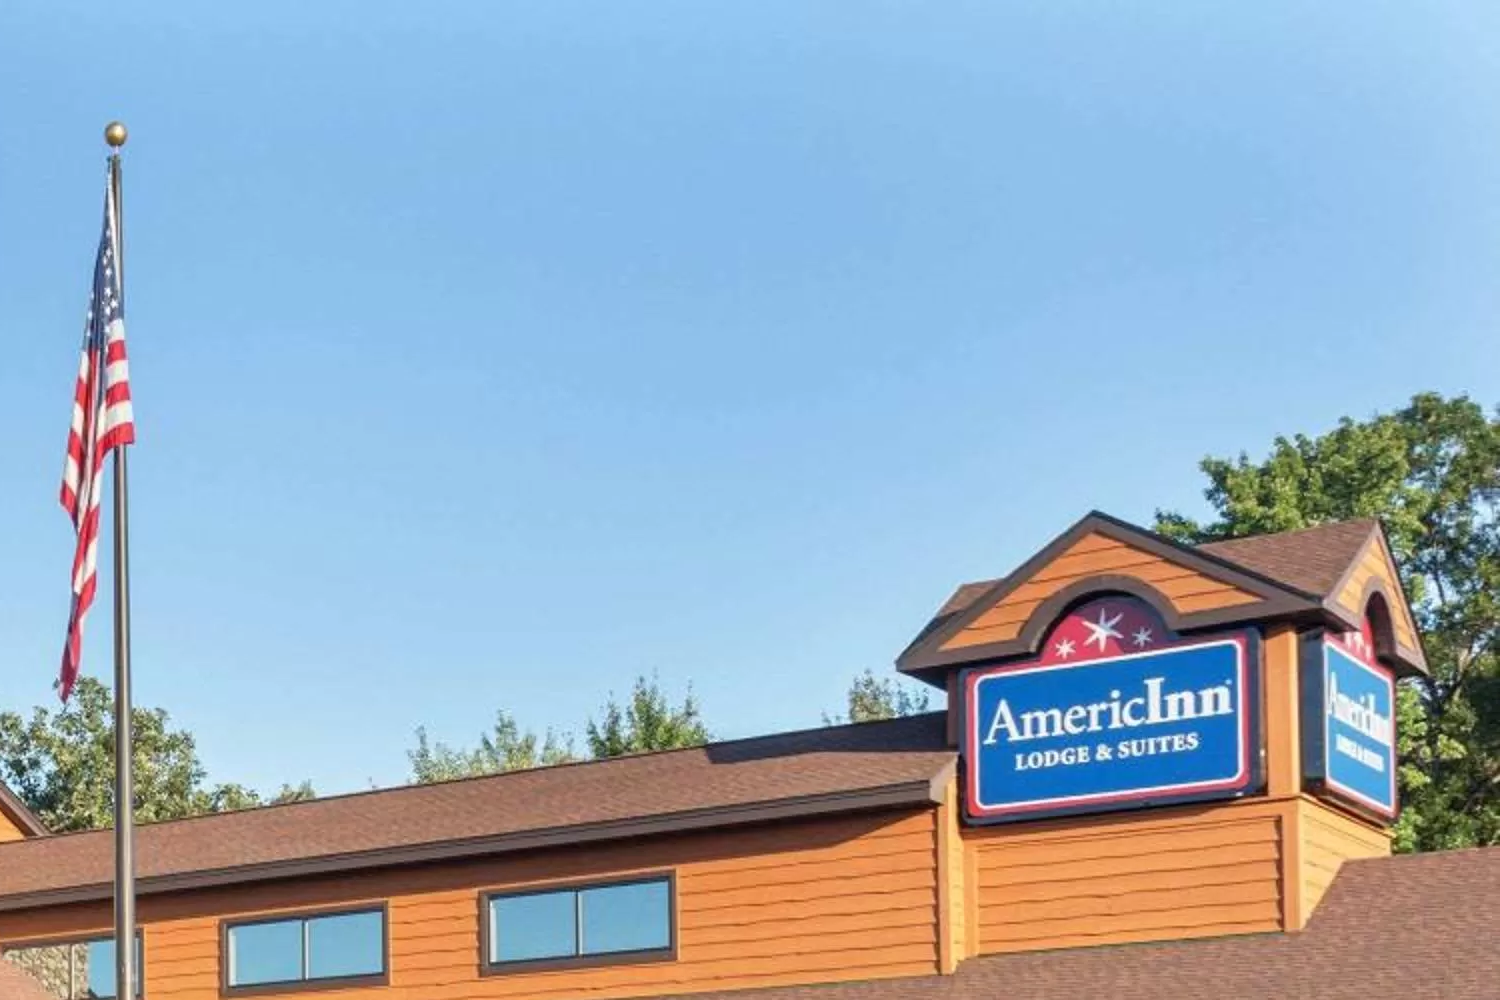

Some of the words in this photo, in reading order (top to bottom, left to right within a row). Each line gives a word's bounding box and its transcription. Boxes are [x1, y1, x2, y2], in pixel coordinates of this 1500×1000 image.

[983, 677, 1233, 745] AmericInn
[1015, 747, 1090, 771] LODGE
[1095, 744, 1113, 761] &
[1117, 732, 1199, 760] SUITES
